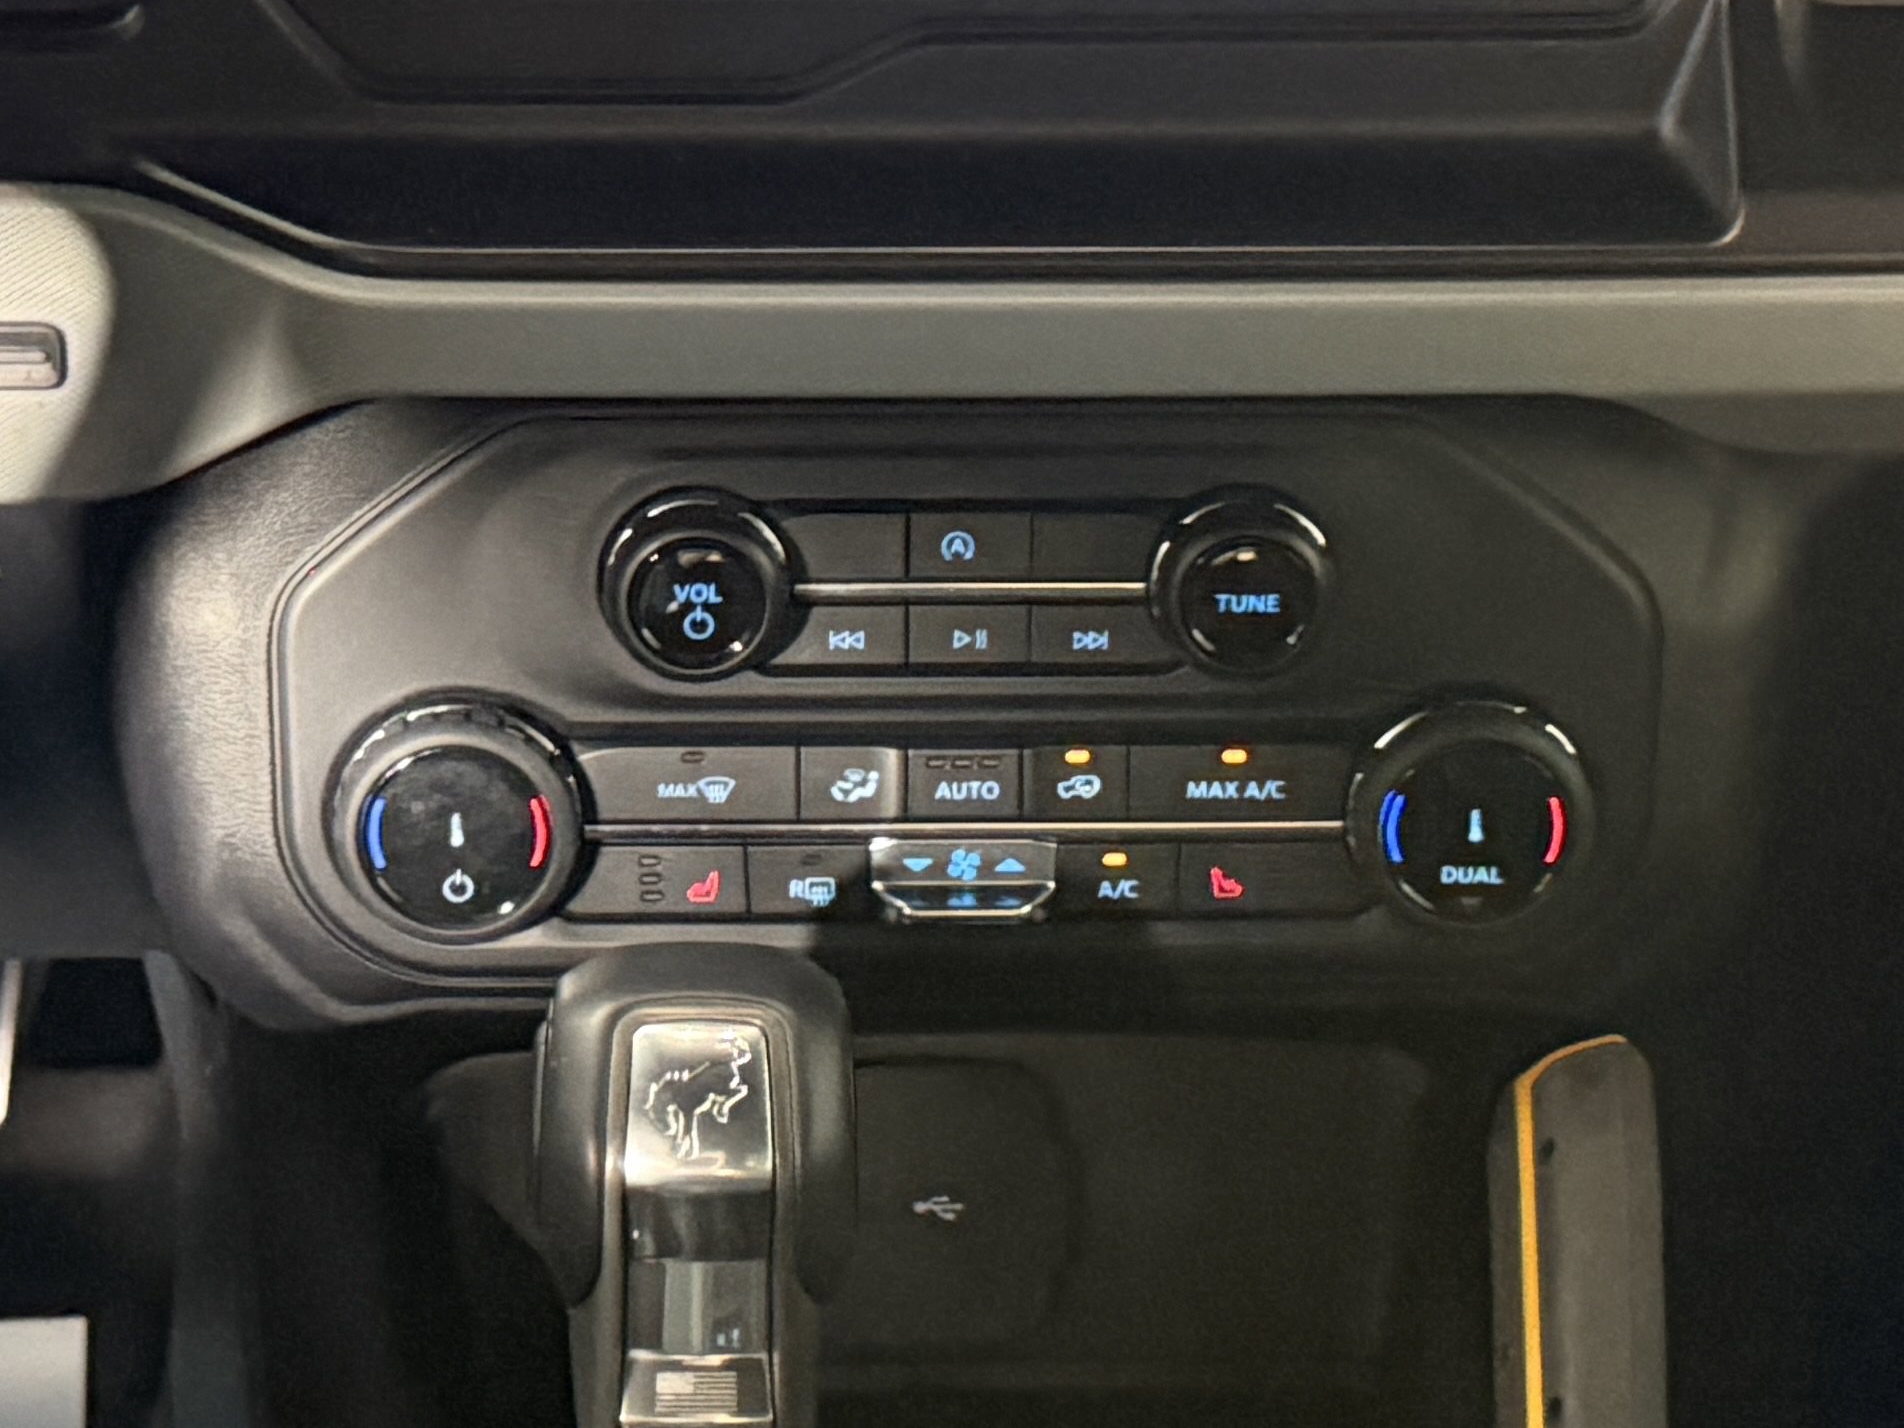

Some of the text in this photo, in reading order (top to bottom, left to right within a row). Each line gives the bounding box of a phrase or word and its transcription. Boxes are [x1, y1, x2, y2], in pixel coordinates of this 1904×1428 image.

[674, 584, 723, 606] VOL
[1214, 594, 1281, 614] TUNE
[935, 780, 1000, 801] AUTO
[1186, 781, 1286, 800] MAX A/C
[1440, 867, 1503, 885] DUAL
[1098, 879, 1139, 900] A/C
